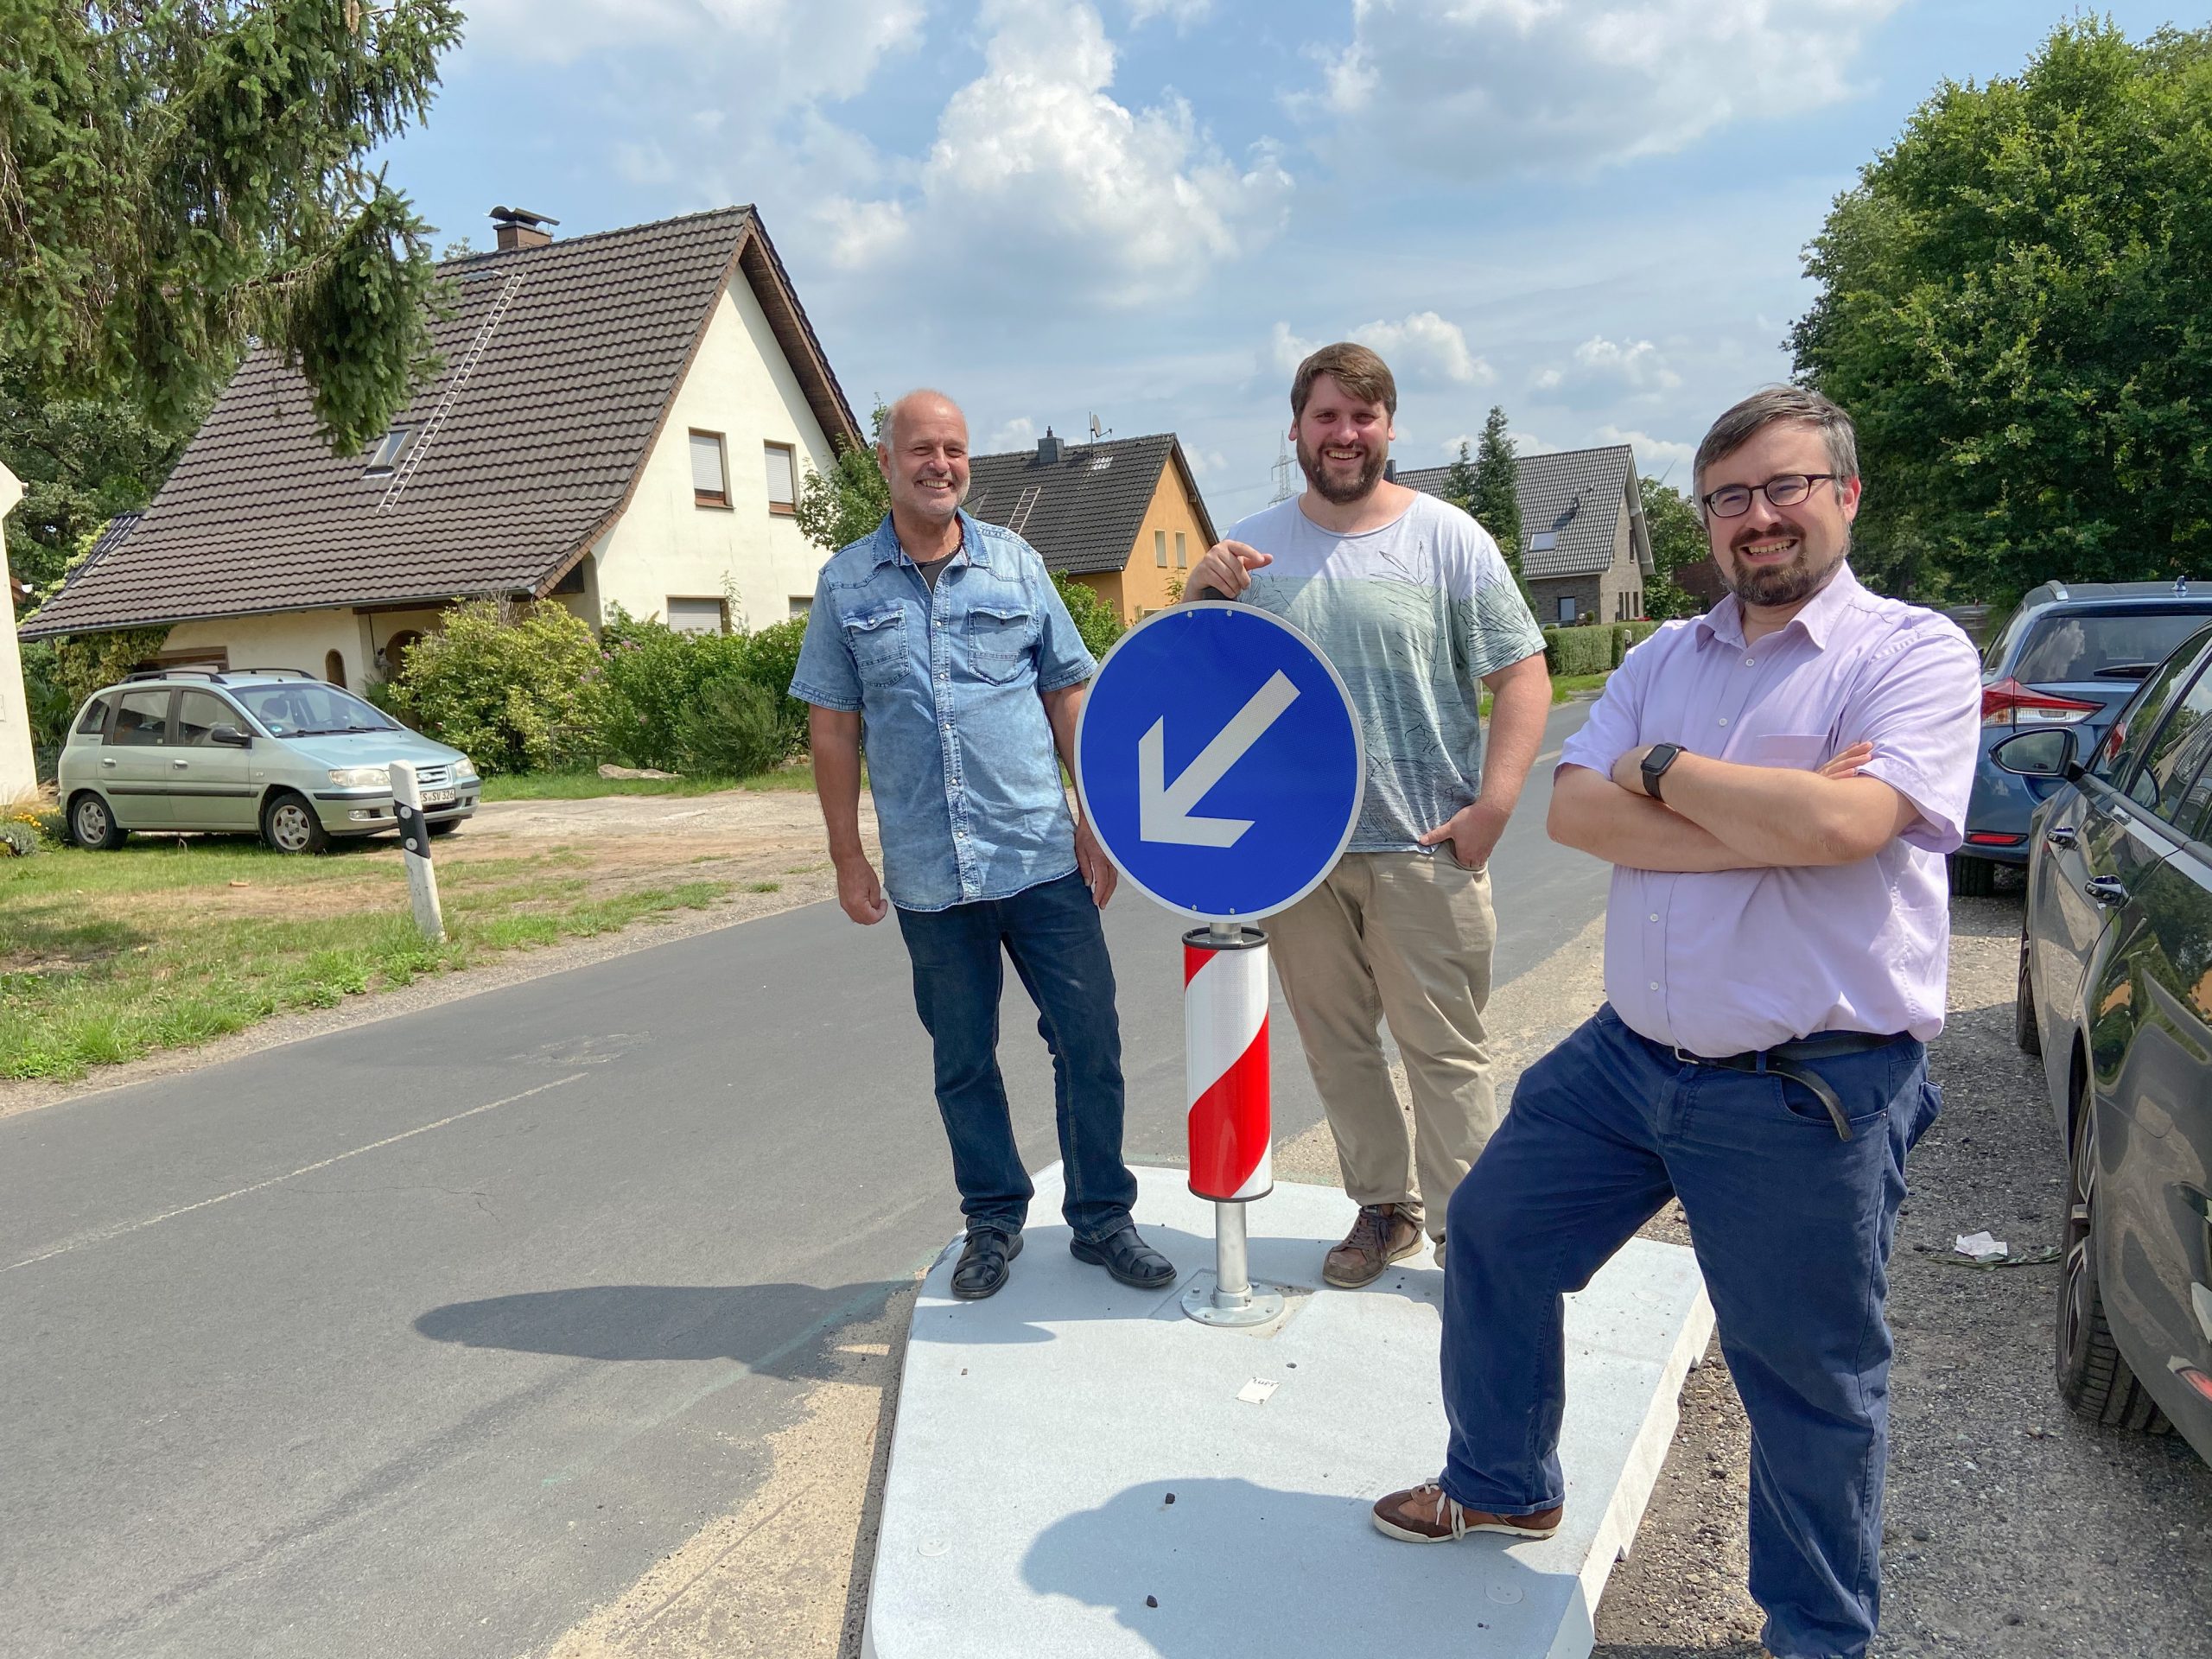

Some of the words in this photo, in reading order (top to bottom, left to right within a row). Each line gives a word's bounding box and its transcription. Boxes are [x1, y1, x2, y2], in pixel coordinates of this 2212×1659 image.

[420, 792, 428, 802] S
[432, 791, 441, 801] SV
[442, 790, 454, 800] 326
